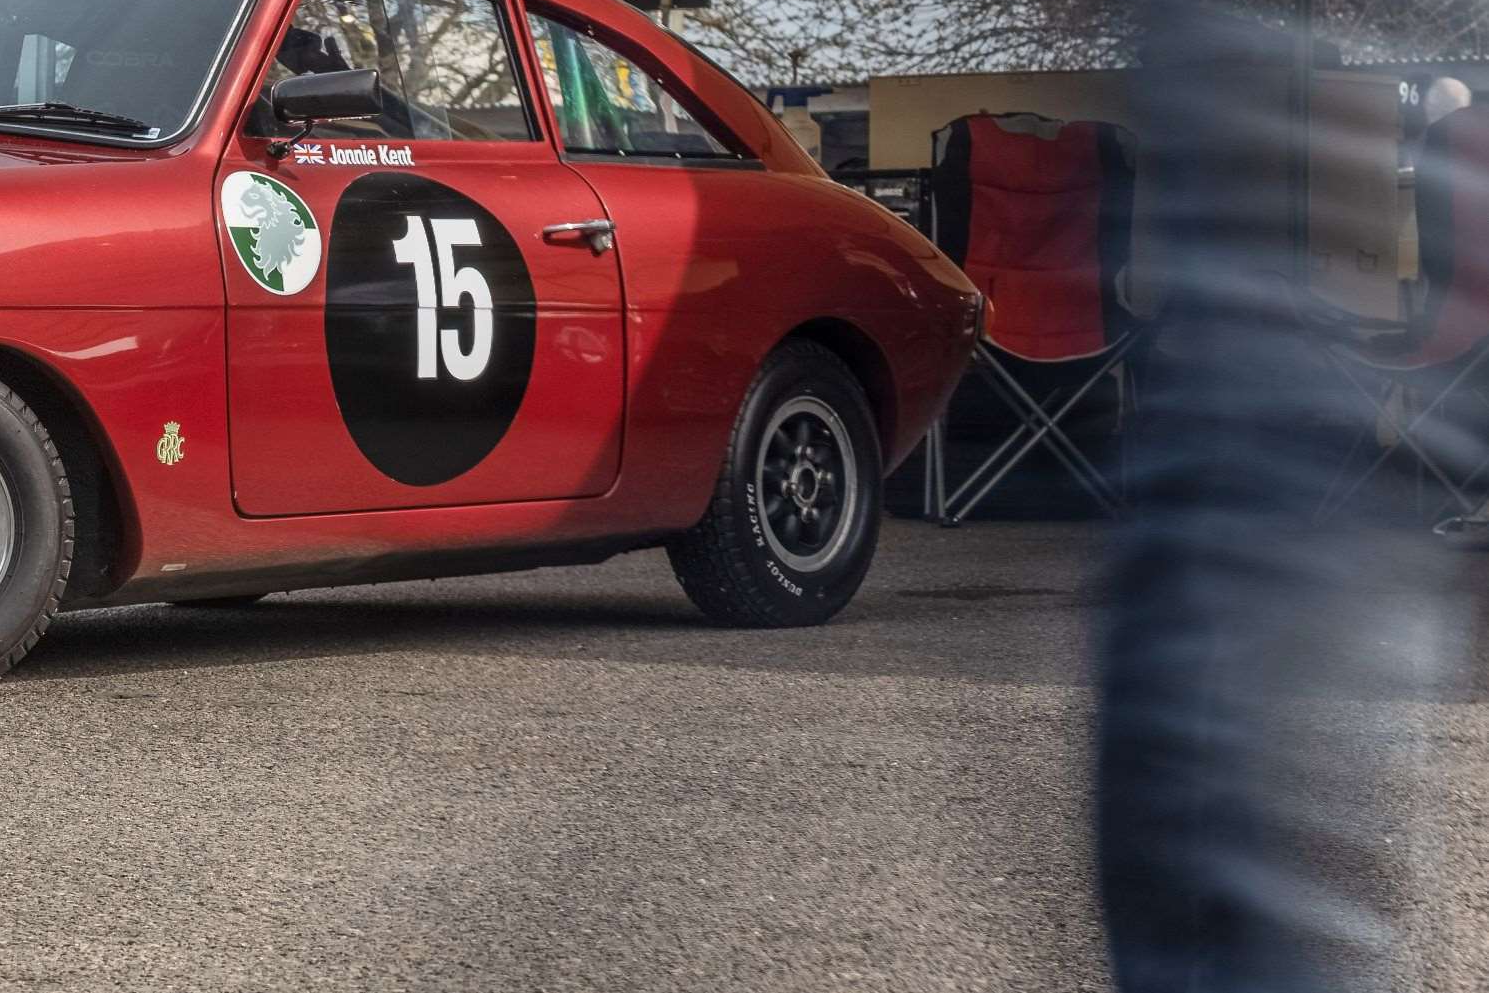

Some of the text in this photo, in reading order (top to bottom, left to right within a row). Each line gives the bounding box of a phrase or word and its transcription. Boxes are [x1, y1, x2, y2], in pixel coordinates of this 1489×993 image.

[1399, 81, 1420, 106] 96
[329, 144, 415, 166] Jonnie Kent
[392, 215, 493, 380] 15
[746, 483, 765, 547] RACING
